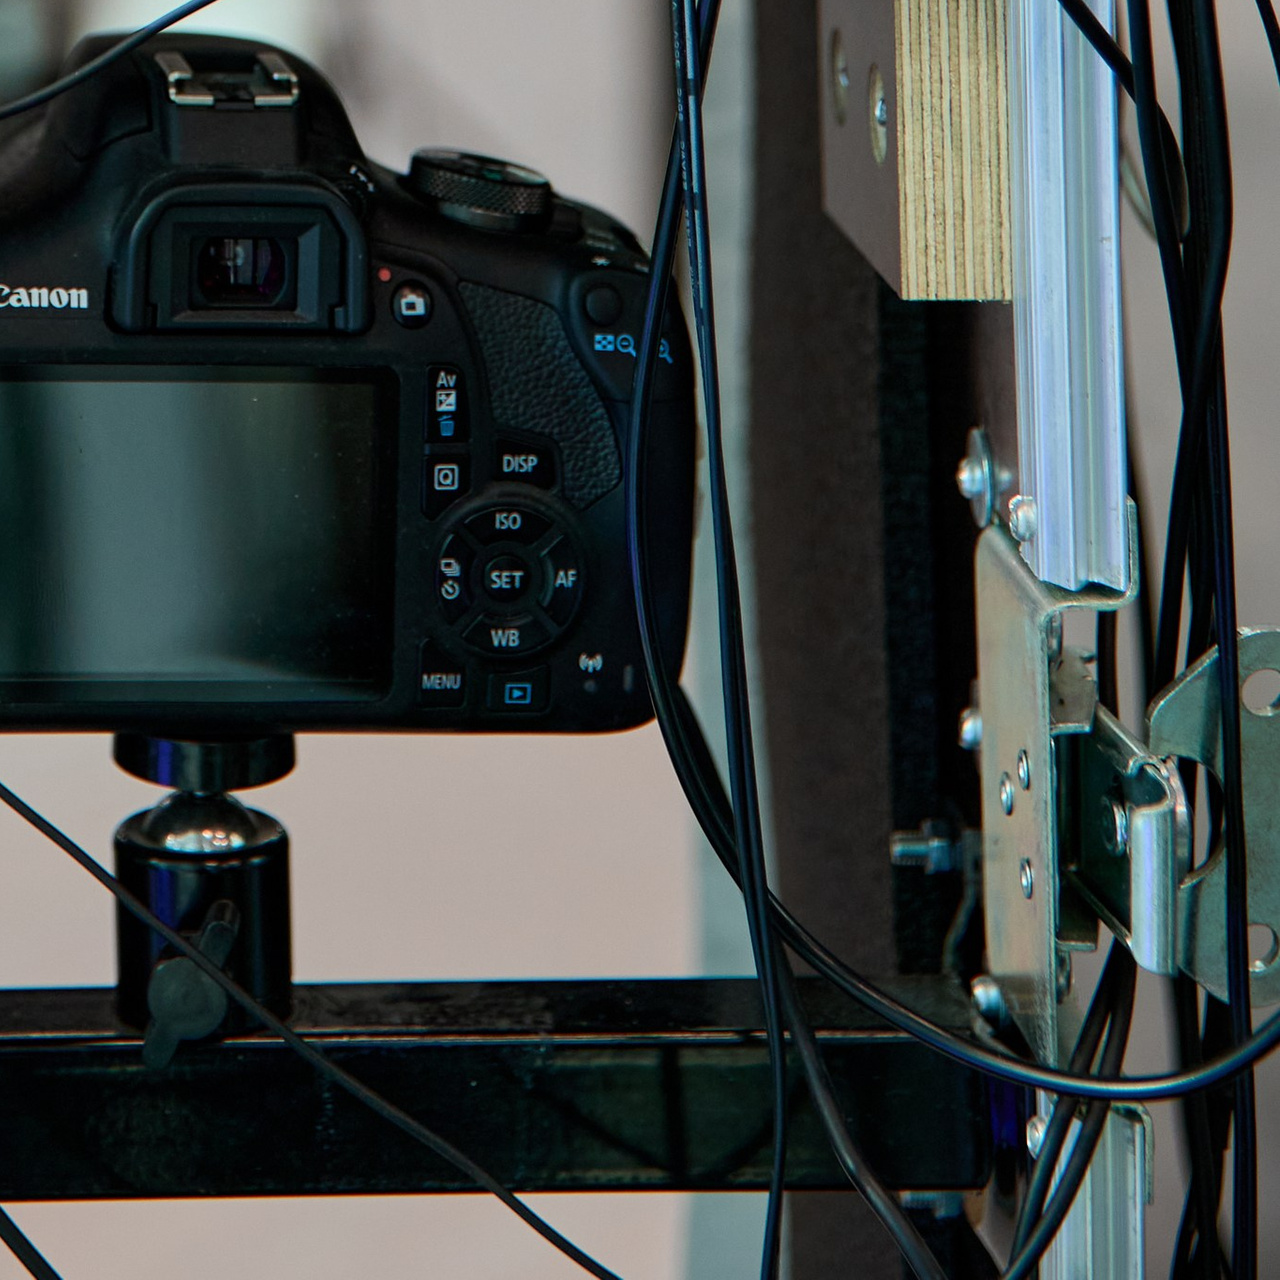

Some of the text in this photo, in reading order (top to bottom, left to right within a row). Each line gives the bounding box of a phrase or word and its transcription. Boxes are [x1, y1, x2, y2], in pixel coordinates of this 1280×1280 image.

[436, 371, 457, 388] Av
[502, 454, 538, 473] DISP
[495, 511, 522, 530] ISO
[490, 570, 524, 589] SET
[555, 569, 577, 588] AF
[491, 629, 520, 648] WB
[422, 673, 462, 691] MENU
